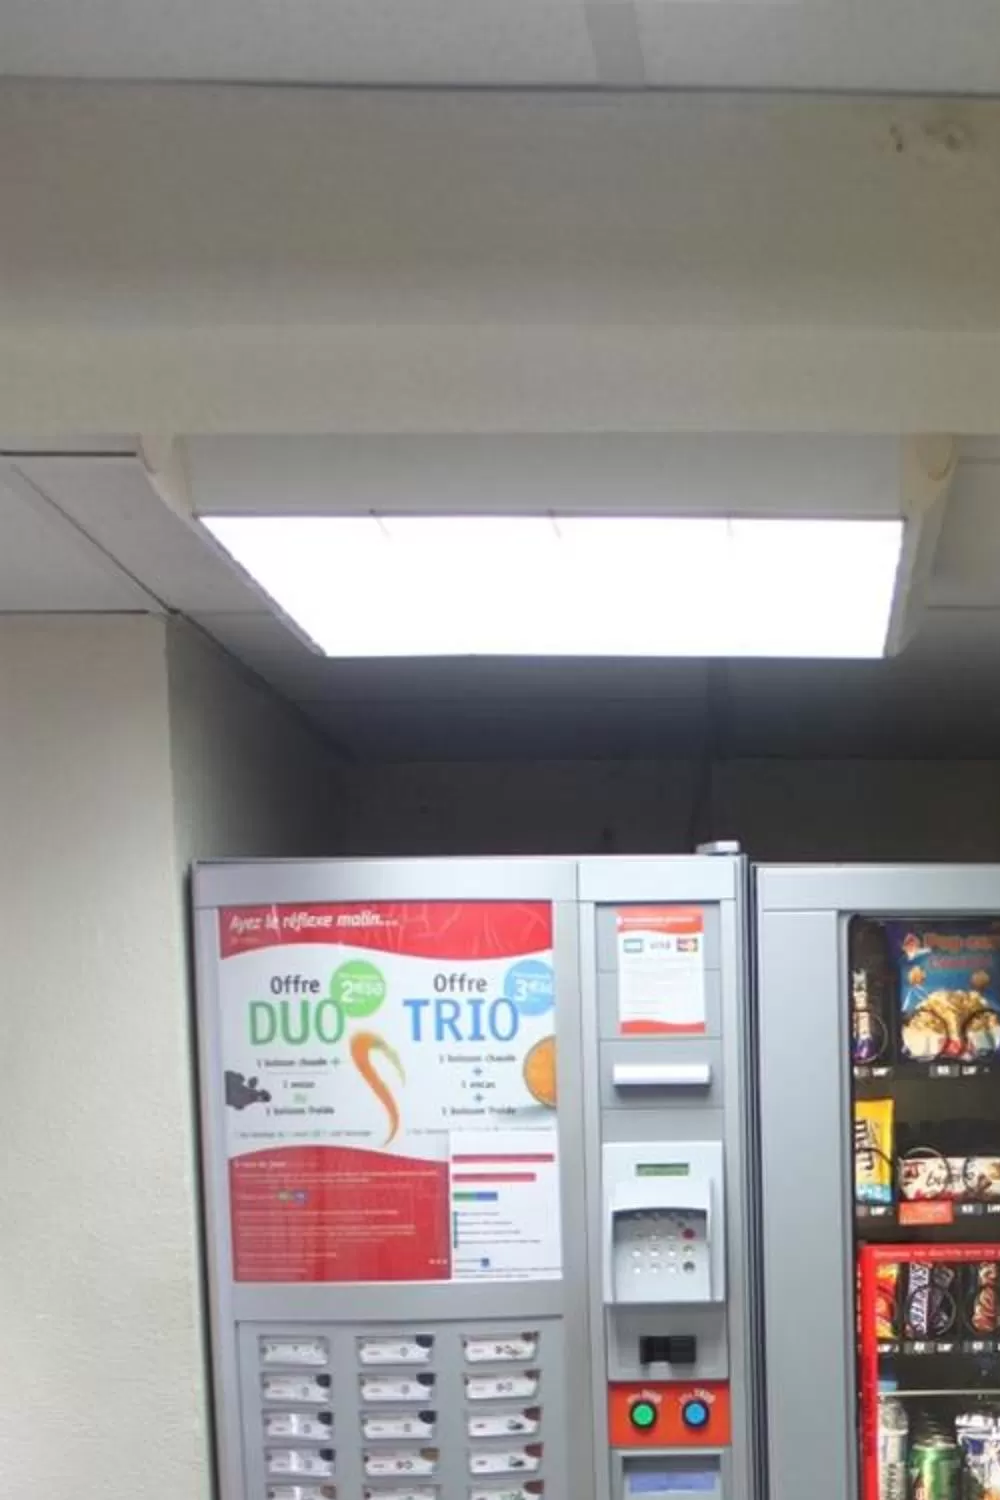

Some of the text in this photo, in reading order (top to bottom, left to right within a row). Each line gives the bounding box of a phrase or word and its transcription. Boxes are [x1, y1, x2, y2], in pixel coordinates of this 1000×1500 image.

[270, 975, 321, 995] Offre
[433, 972, 489, 993] Offre
[249, 998, 346, 1047] DUO
[402, 997, 520, 1042] TRIO
